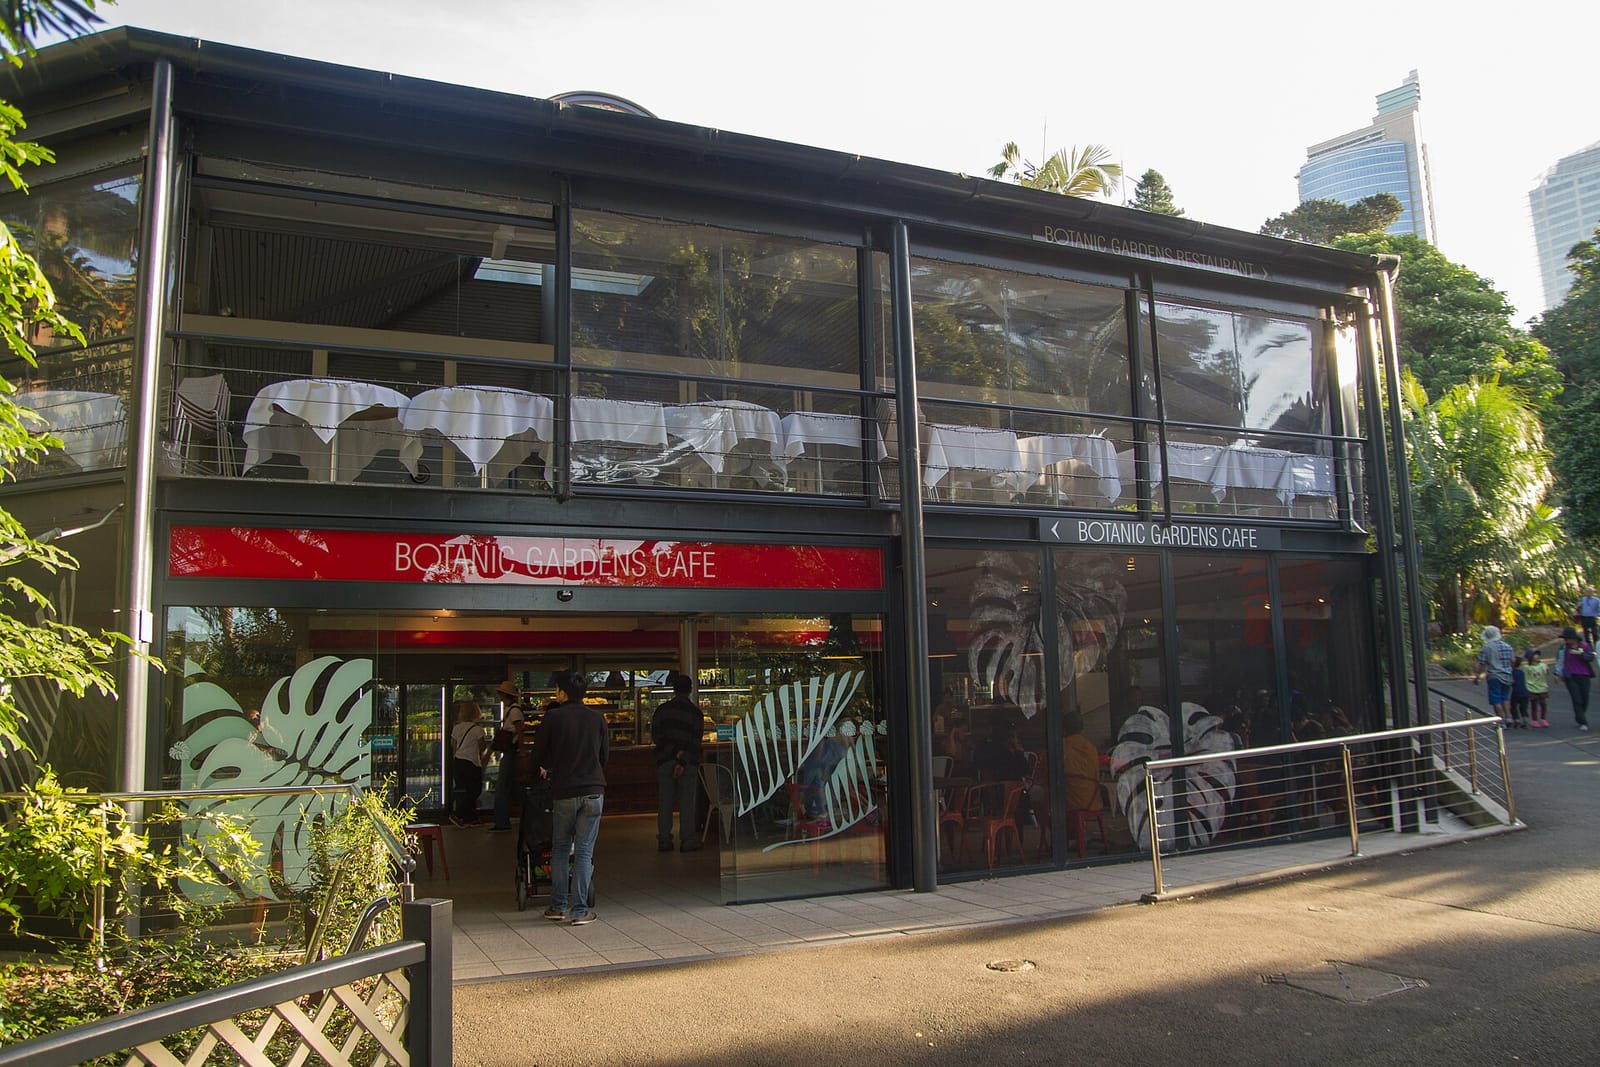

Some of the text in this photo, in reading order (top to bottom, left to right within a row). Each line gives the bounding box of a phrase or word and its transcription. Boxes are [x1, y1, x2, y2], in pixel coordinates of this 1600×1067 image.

[1044, 225, 1254, 278] BOTANIC GARDENS RESTAURANT
[1078, 521, 1258, 548] BOTANIC GARDENS CAFE
[395, 541, 716, 579] BOTANIC GARDENS CAFE
